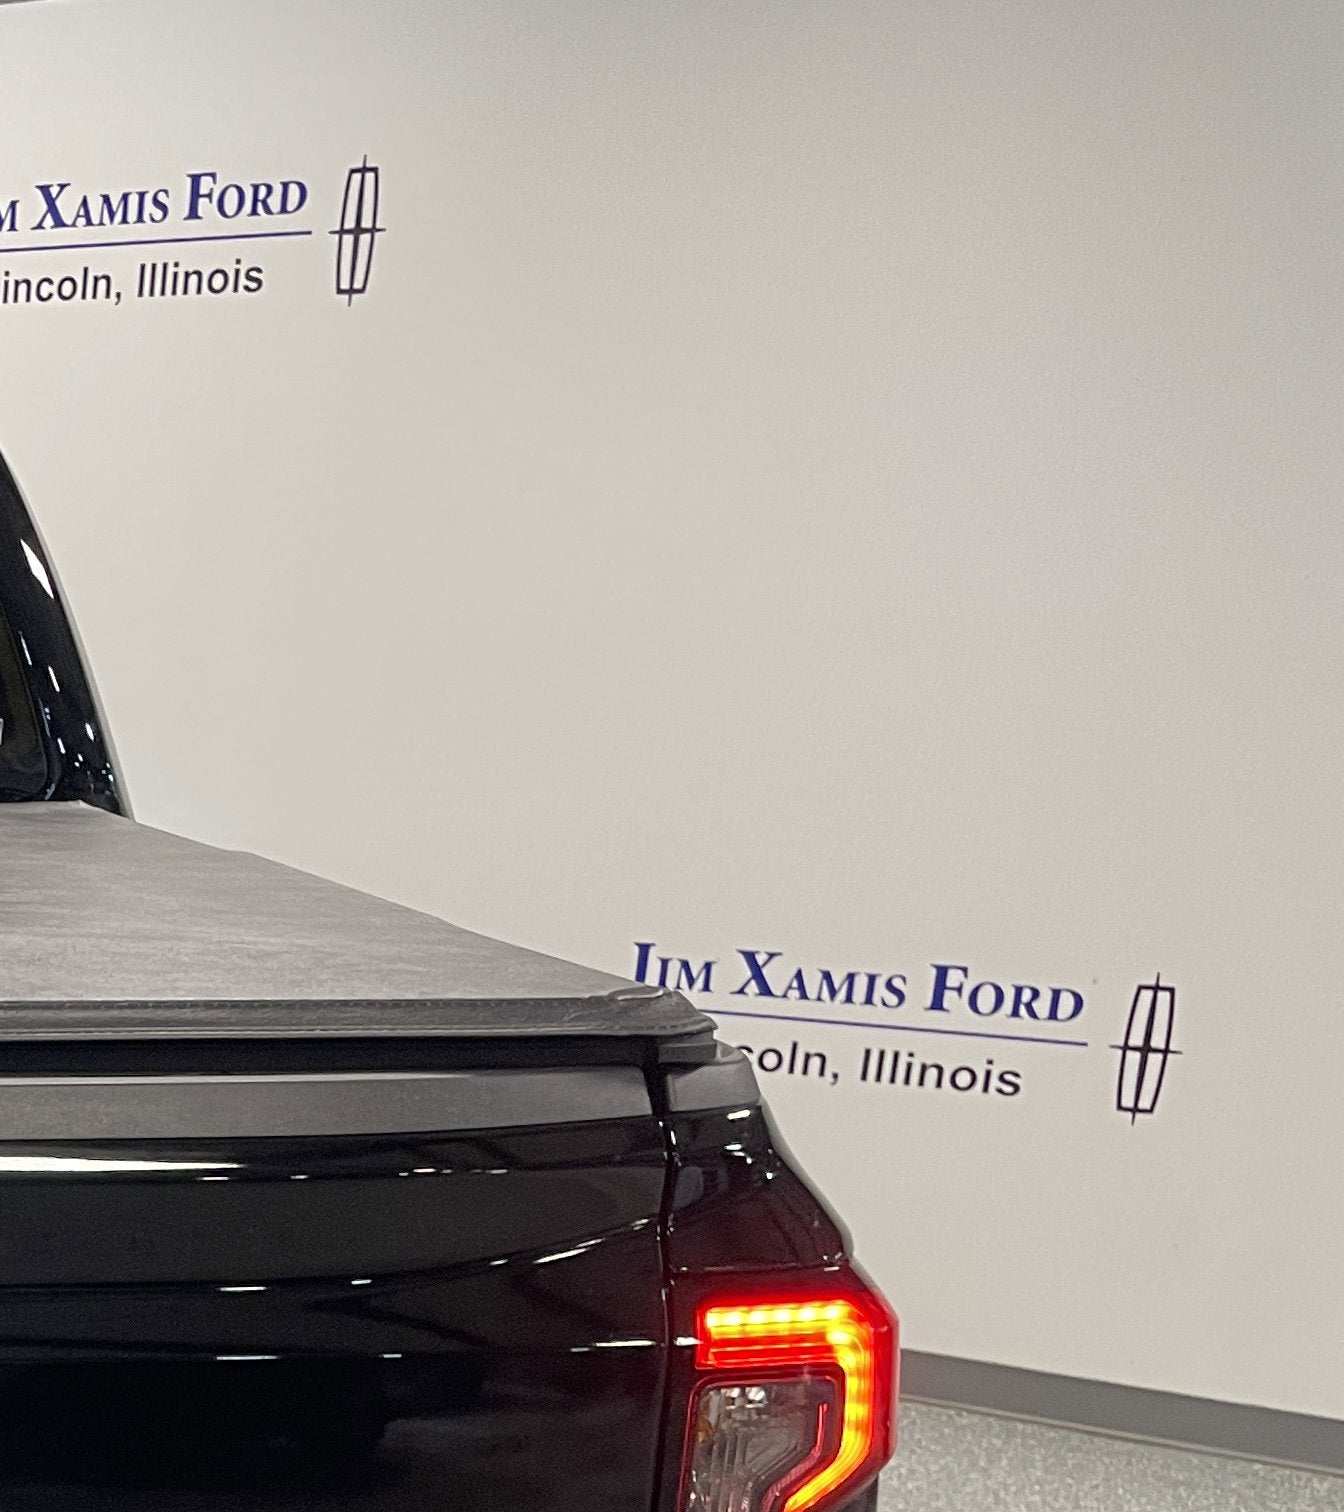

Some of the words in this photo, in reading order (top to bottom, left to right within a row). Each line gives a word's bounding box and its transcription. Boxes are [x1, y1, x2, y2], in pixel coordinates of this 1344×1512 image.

[30, 183, 170, 232] XAMIS
[183, 172, 308, 222] FORD
[137, 258, 264, 299] Illinois
[730, 948, 908, 1009] XAMIS
[924, 963, 1085, 1022] FORD
[736, 1040, 840, 1087] oln,
[860, 1047, 1023, 1097] Illinois
